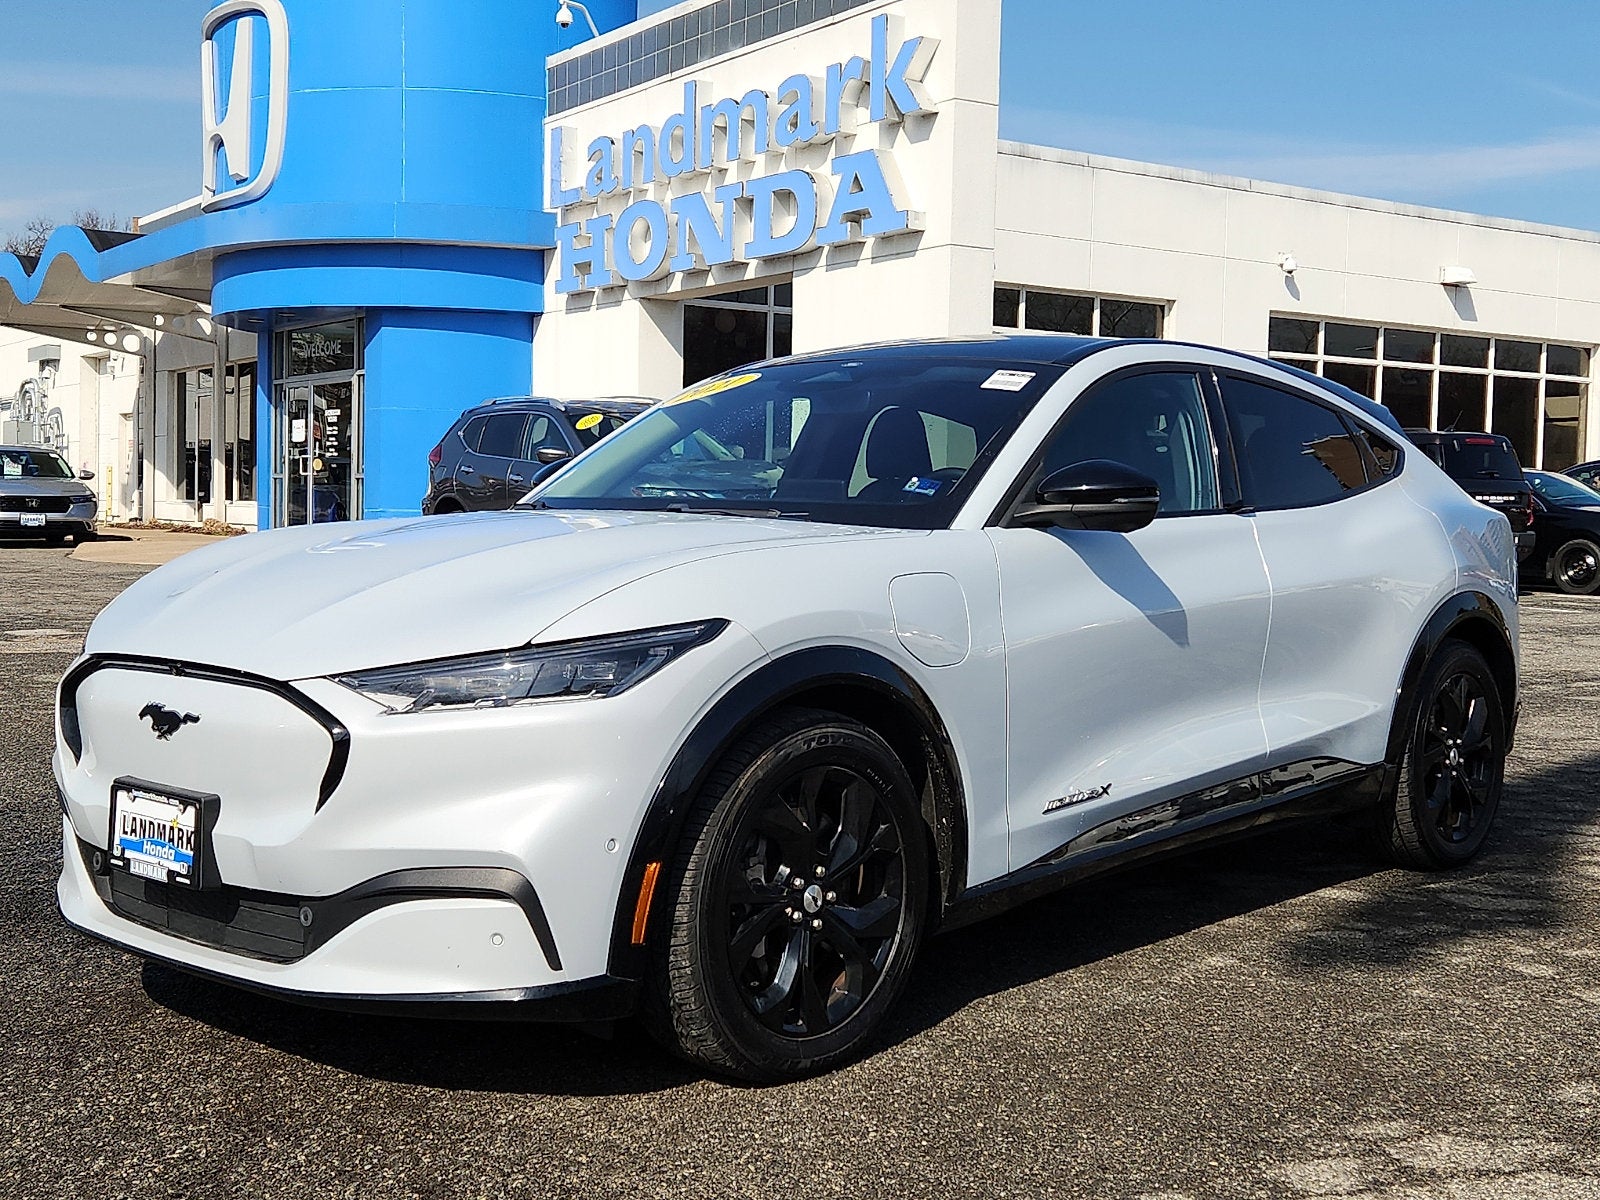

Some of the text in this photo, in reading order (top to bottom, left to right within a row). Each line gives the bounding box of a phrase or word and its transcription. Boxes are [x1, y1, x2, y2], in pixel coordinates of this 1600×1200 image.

[550, 13, 928, 208] Landmark
[555, 149, 909, 294] HONDA
[122, 814, 195, 852] LANDMARK
[143, 841, 176, 861] Honda
[130, 861, 168, 883] LANDMARK
